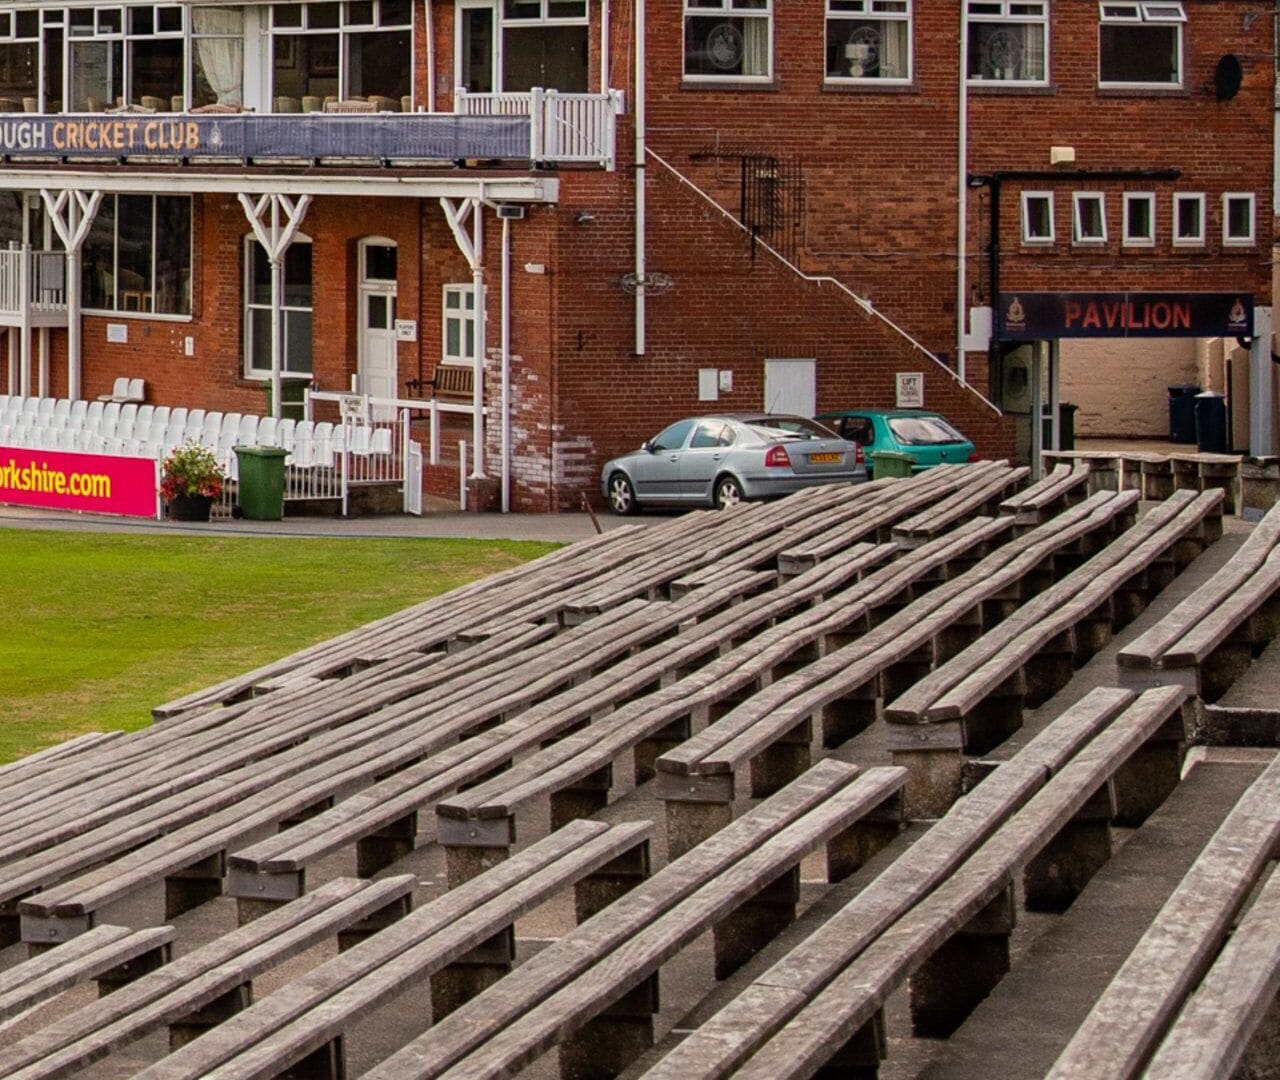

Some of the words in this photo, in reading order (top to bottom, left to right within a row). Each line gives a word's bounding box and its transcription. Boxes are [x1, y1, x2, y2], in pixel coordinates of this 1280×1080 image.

[52, 122, 138, 148] CRICKET
[144, 122, 200, 149] CLUB
[1064, 302, 1190, 328] PAVILION
[902, 377, 917, 385] LIFT
